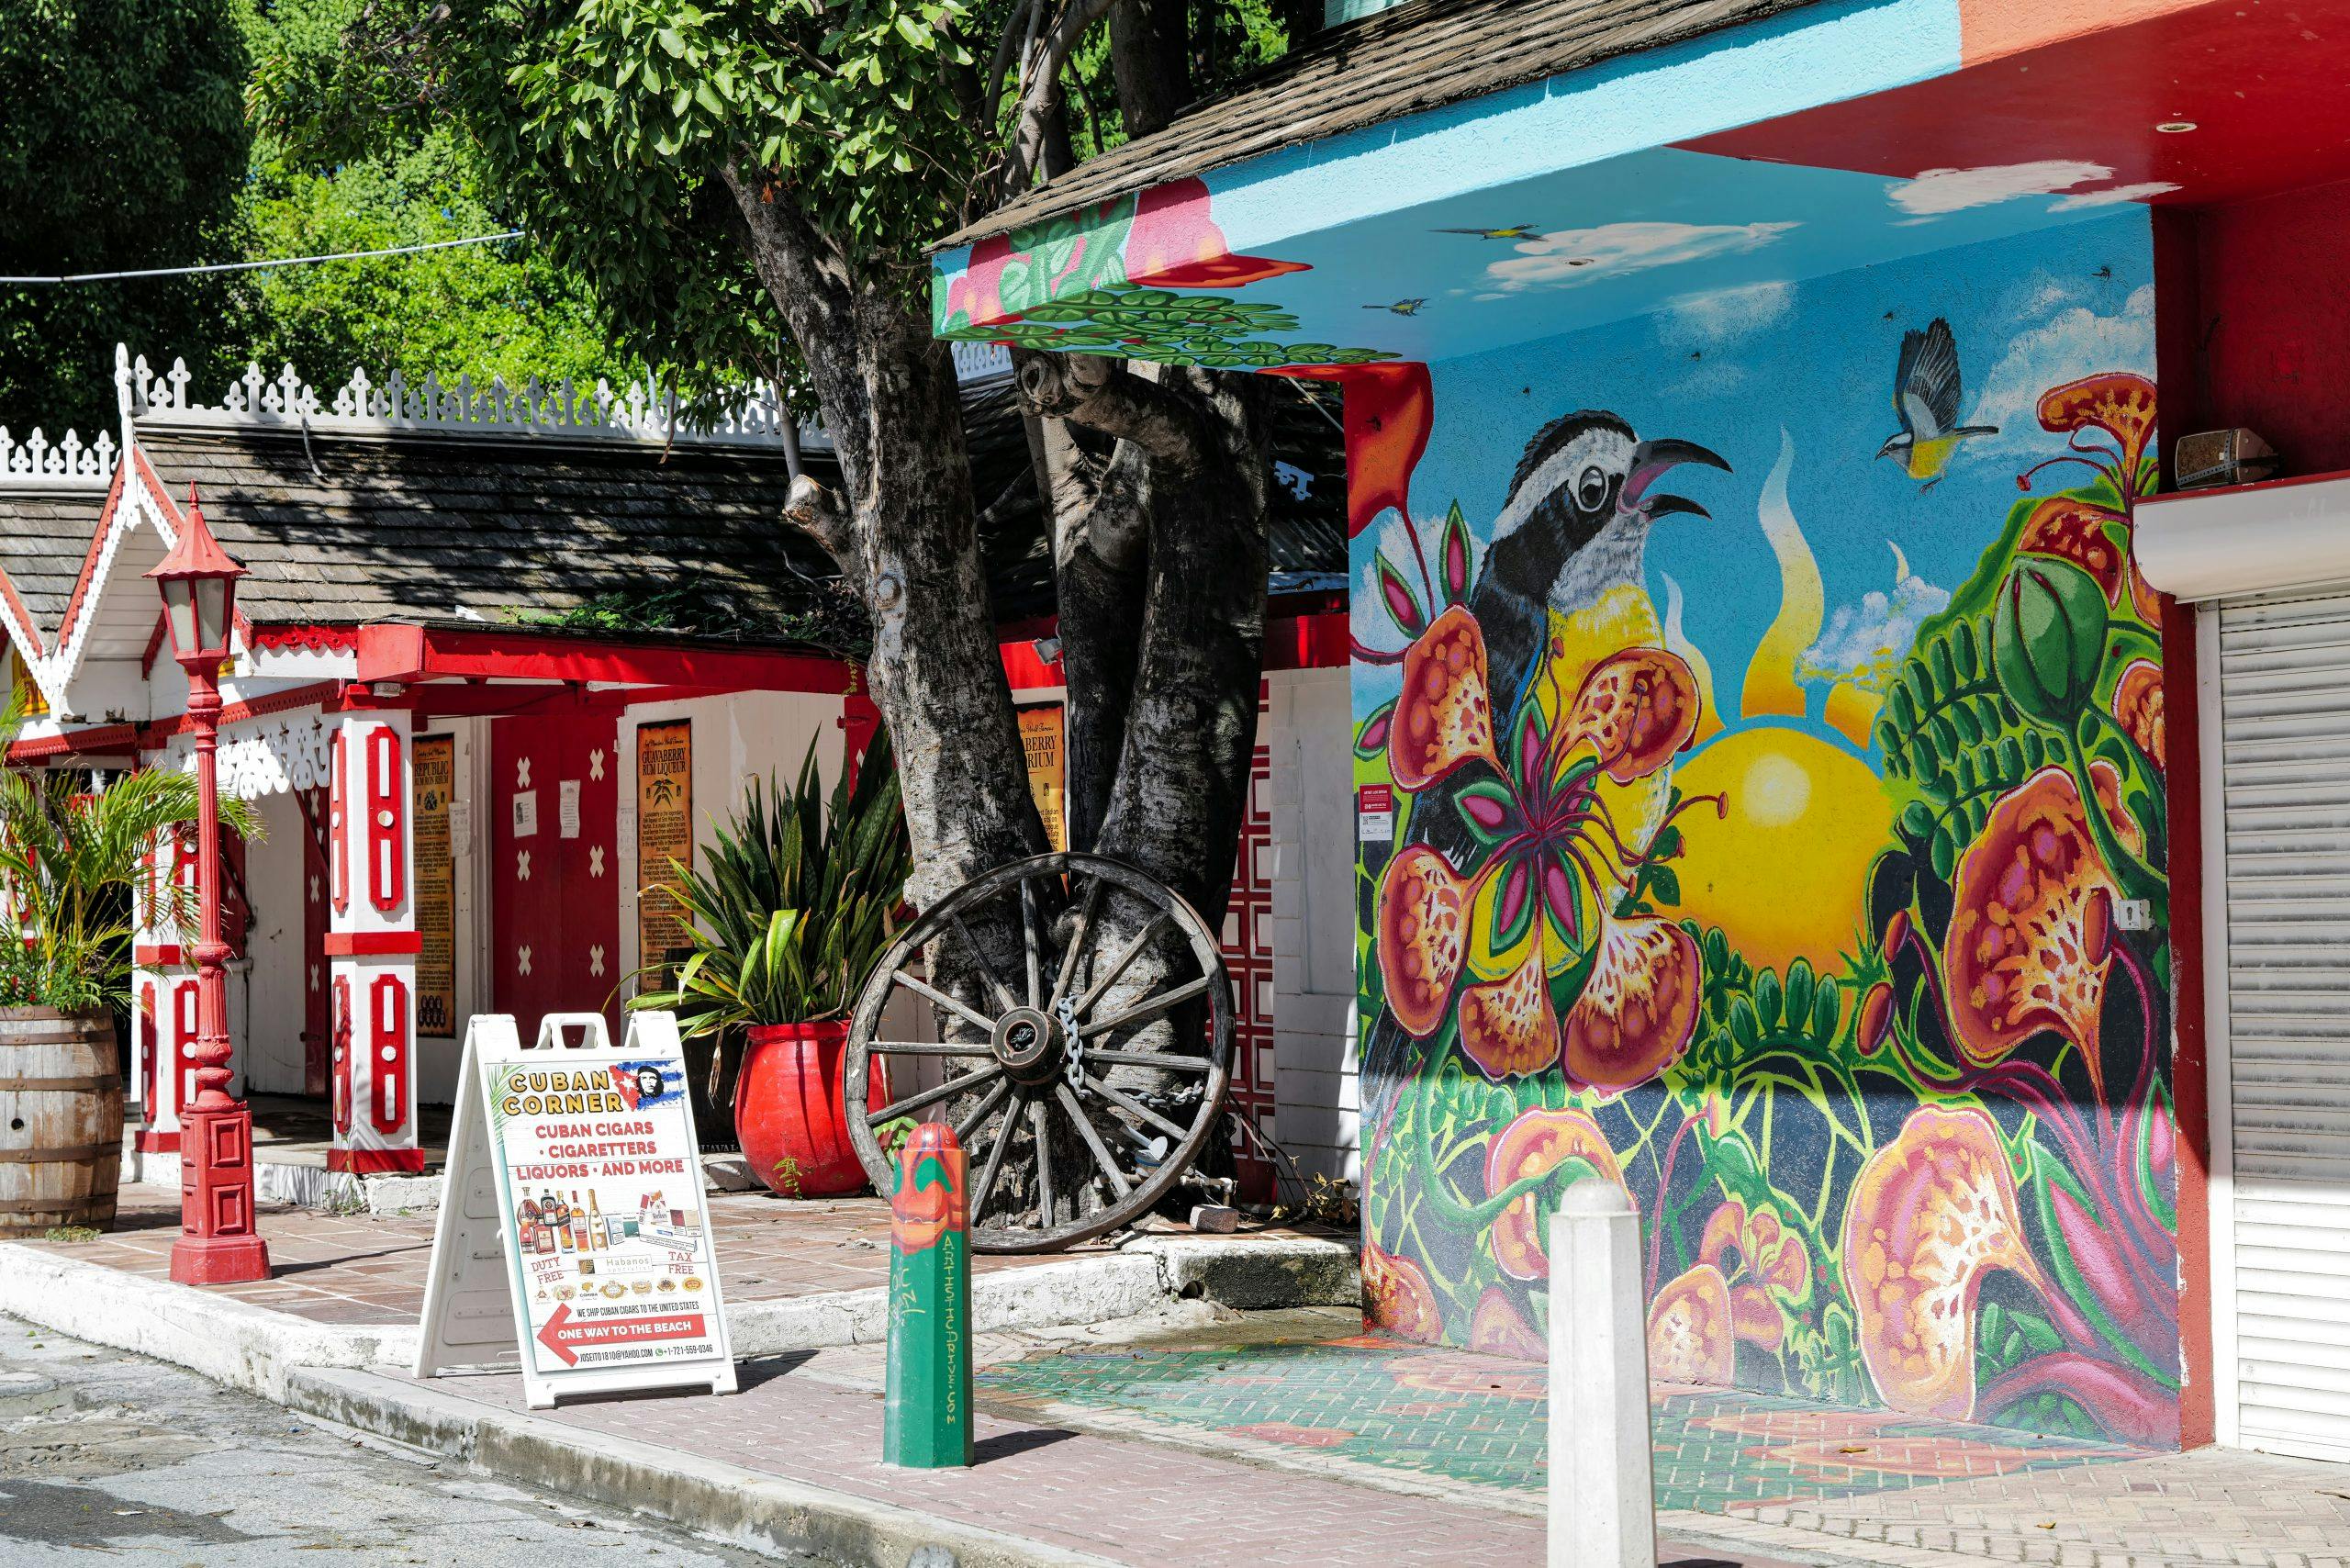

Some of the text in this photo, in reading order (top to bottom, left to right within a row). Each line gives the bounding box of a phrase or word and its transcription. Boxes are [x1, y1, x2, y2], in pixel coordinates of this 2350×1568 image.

[1024, 735, 1057, 751] BERRY
[643, 747, 686, 764] GUAVABERRY
[1027, 752, 1054, 767] RIUM
[414, 761, 448, 778] REPUBLIC
[643, 761, 686, 776] RUM LIQUEUR
[509, 1070, 610, 1092] CUBAN
[502, 1092, 623, 1115] CORNER
[535, 1121, 655, 1139] CUBAN CIGARS
[548, 1141, 657, 1159] CIGARETTERS
[516, 1159, 685, 1181] LIQUORS AND MORE
[531, 1256, 561, 1272] DUTY
[606, 1257, 649, 1267] Habanos
[668, 1250, 692, 1262] TAX
[537, 1271, 565, 1285] FREE
[668, 1264, 695, 1275] FREE
[576, 1301, 699, 1317] WE SHIP CUBAN CIGARS TO THE UNITED STATES
[557, 1321, 692, 1339] ONE WAY TO THE BEACH
[942, 1235, 958, 1425] ARTISTICDRIVE.COM
[580, 1343, 713, 1362] JOSEITO1810@YAHOO.COM +1-721-559-0346
